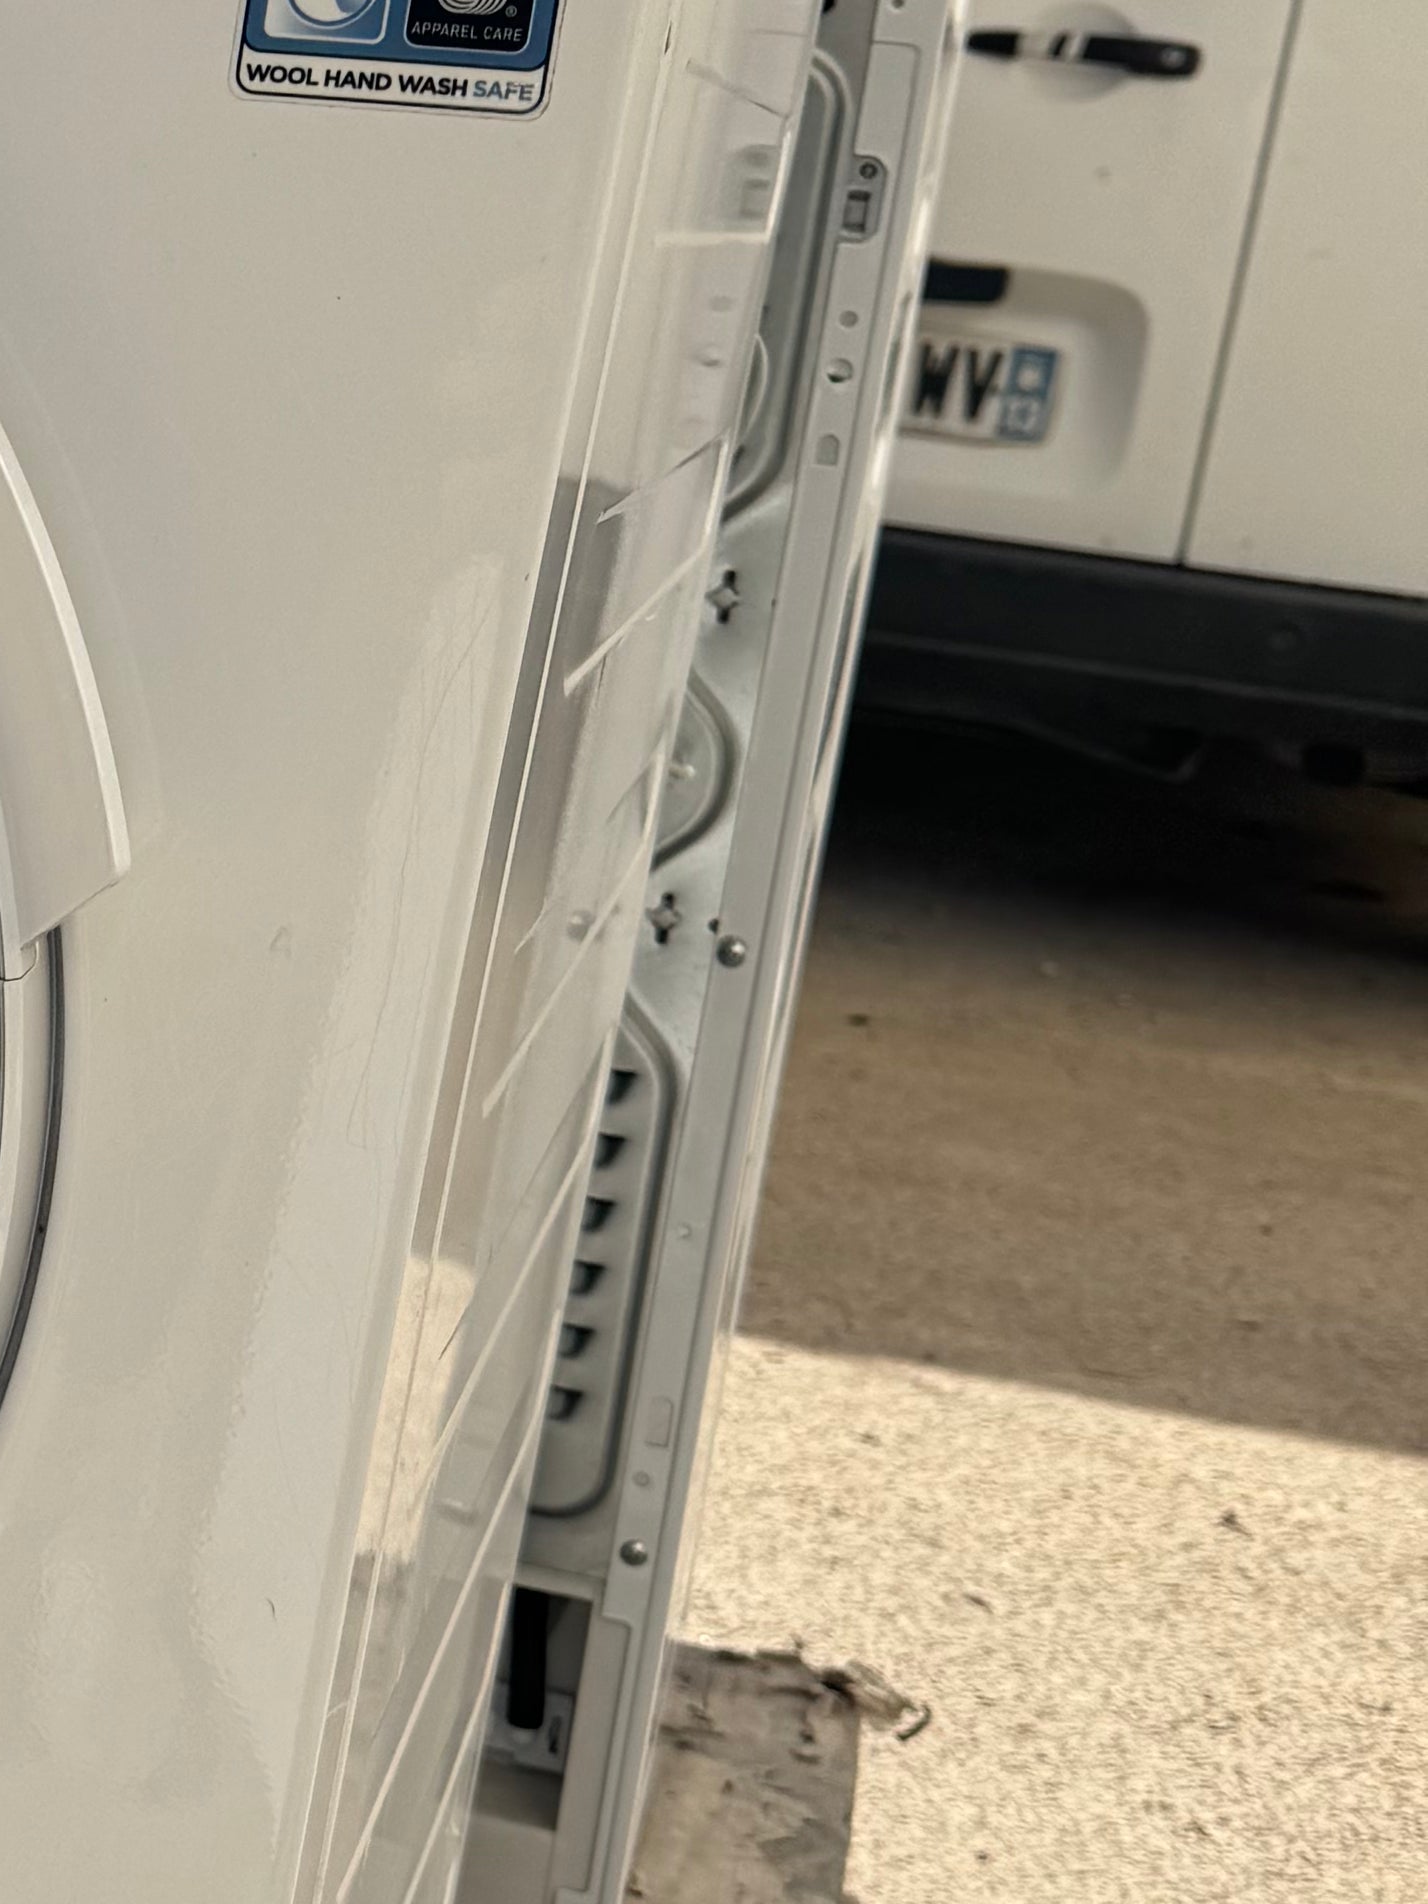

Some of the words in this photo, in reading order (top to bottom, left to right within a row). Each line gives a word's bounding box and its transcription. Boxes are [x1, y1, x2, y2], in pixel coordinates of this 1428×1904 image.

[411, 21, 478, 40] APPAREL
[484, 24, 523, 43] CARE
[246, 63, 319, 86] WOOL
[324, 69, 391, 91] HAND
[398, 74, 468, 97] WASH
[473, 80, 535, 102] SAFE
